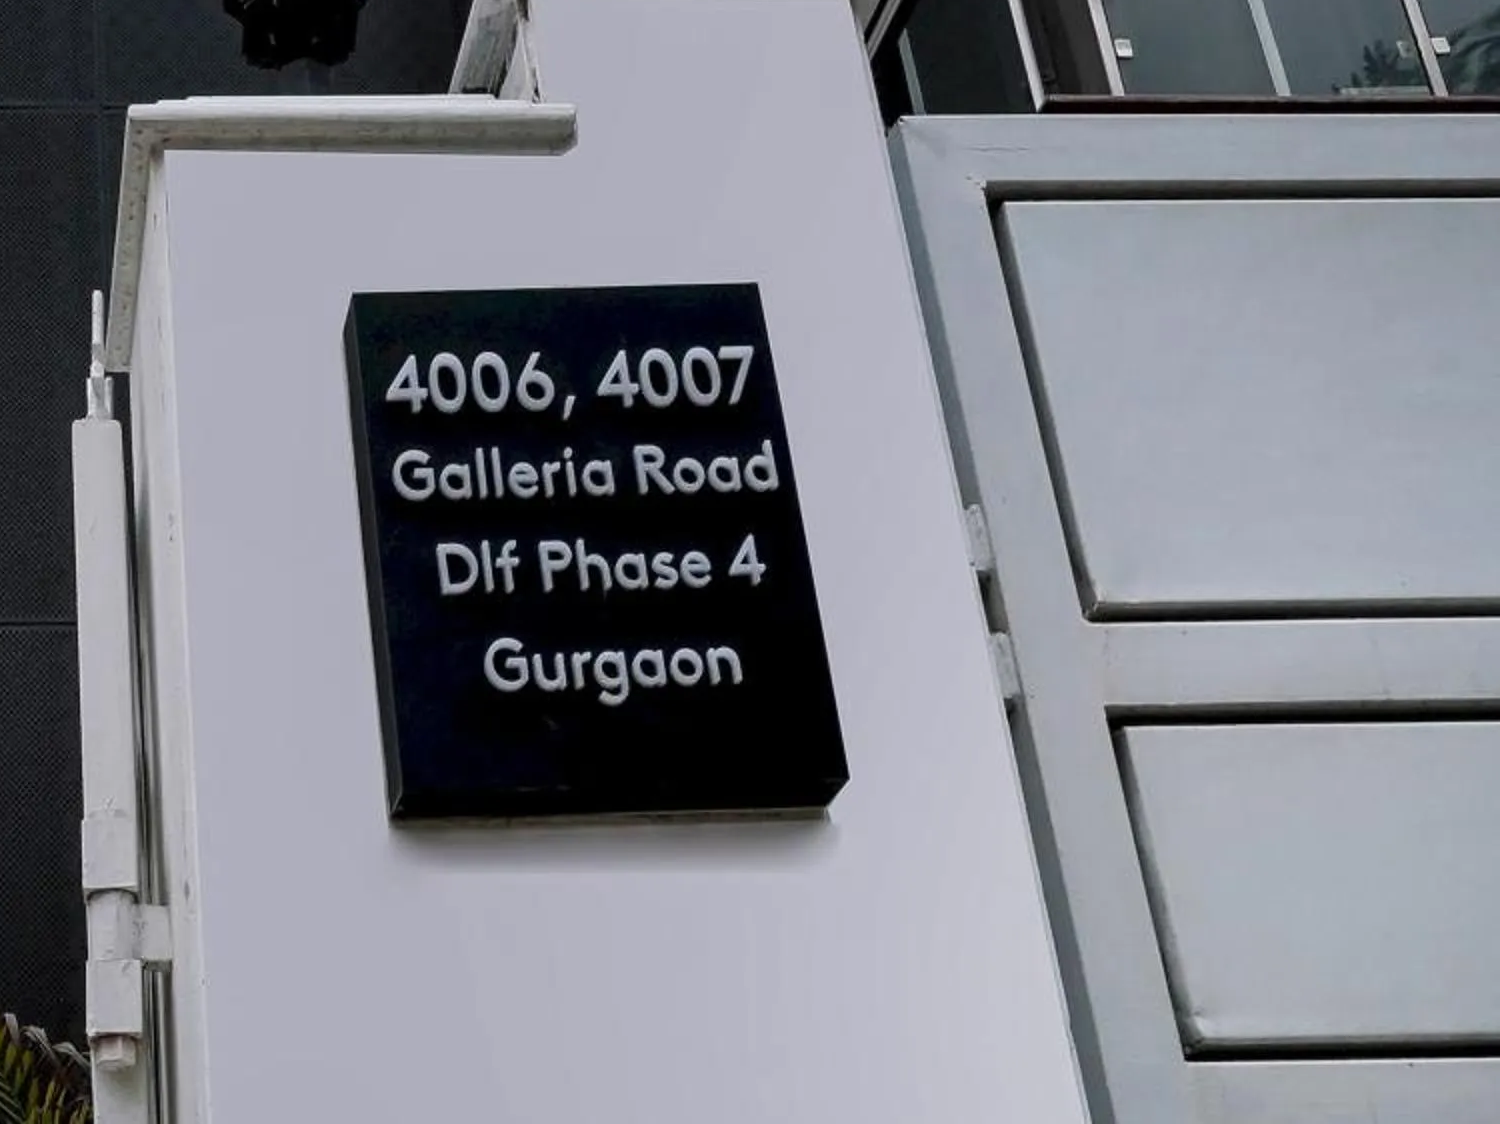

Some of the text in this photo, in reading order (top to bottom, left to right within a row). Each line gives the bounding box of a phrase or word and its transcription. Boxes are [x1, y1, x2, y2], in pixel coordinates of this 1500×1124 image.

[384, 345, 755, 420] 4006, 4007
[391, 439, 780, 501] Galleria Road
[435, 533, 767, 595] Dlf Phase 4
[483, 637, 744, 706] Gurgaon
